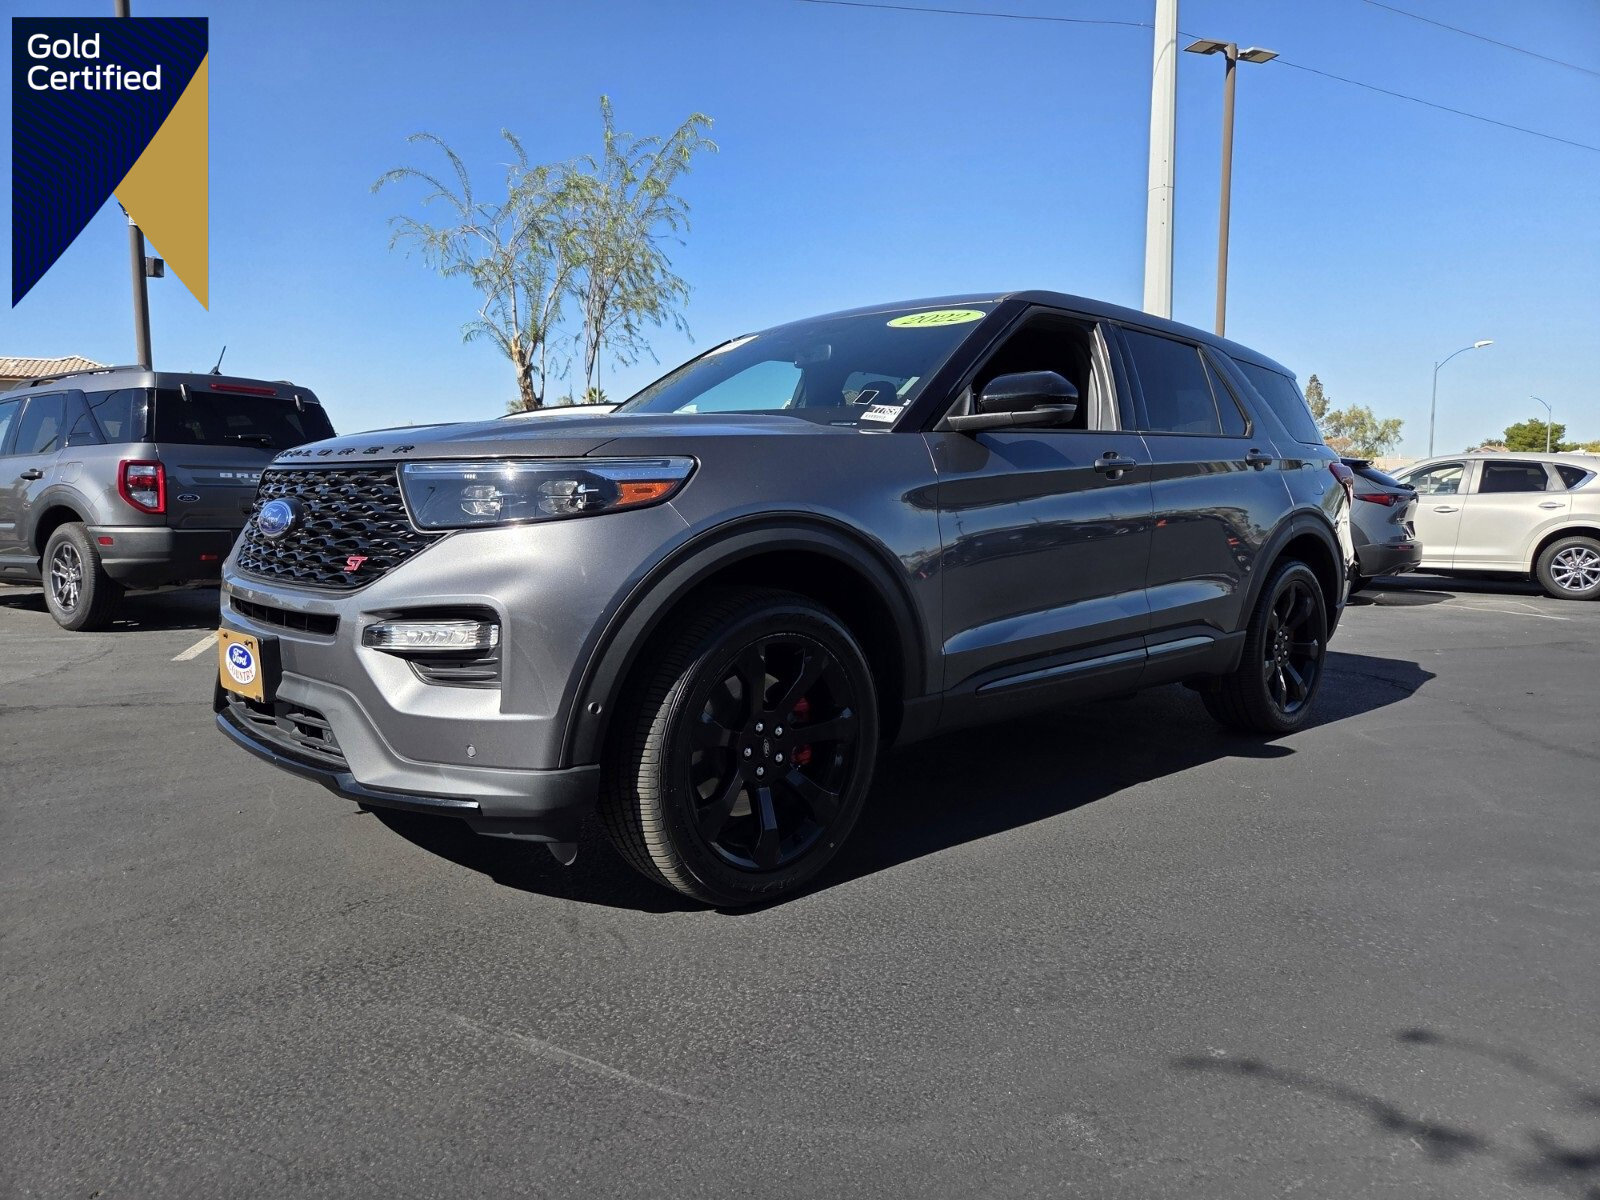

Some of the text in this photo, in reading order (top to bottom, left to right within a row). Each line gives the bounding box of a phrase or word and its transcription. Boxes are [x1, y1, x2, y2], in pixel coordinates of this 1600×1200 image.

[900, 312, 971, 325] 2022
[343, 556, 368, 571] ST
[232, 647, 248, 666] Ford
